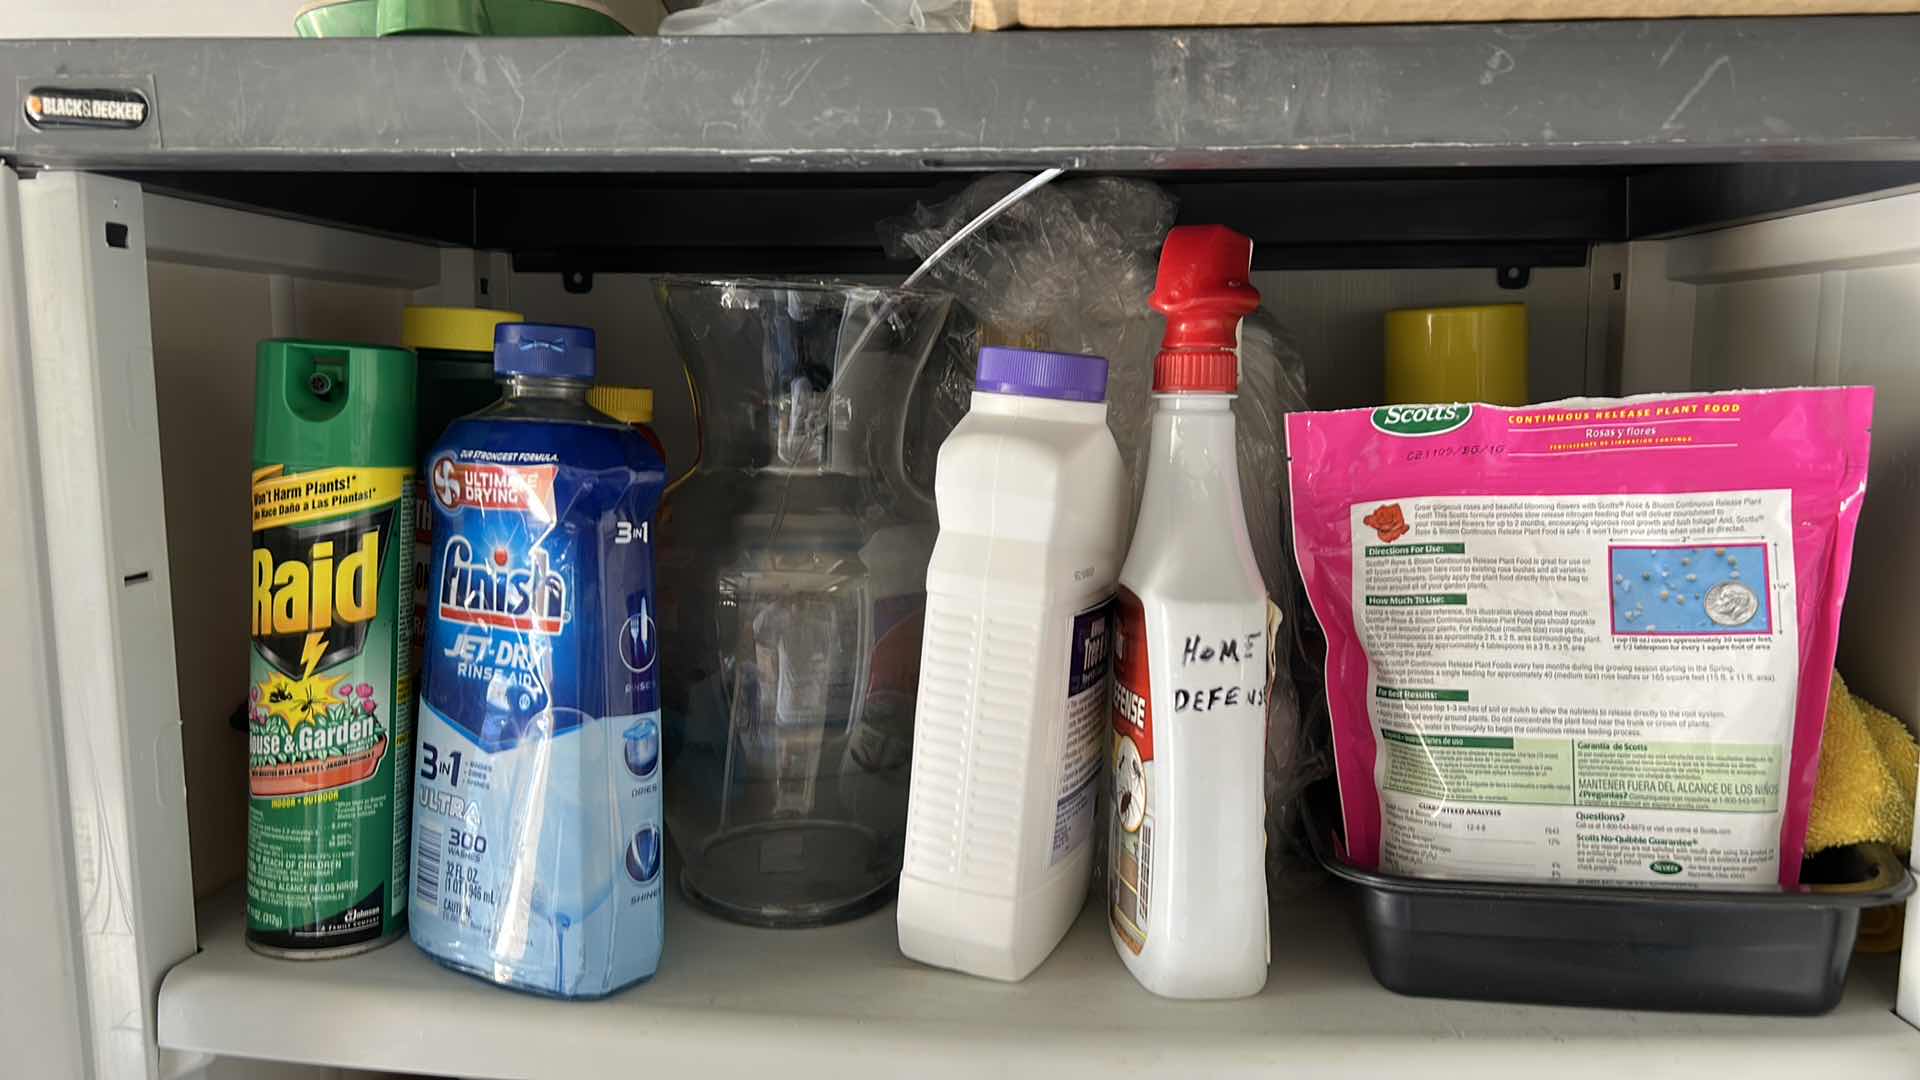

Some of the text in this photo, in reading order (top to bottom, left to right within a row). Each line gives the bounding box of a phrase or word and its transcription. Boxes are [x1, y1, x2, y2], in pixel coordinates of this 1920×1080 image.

[41, 97, 144, 121] BLACK&DECKER
[1384, 406, 1456, 424] Scotts
[1508, 403, 1740, 425] CONTINUOUS RELEASE PLANT FOOD
[1585, 426, 1656, 440] Rosas y flores
[473, 450, 517, 462] STRONGEST
[464, 471, 539, 488] ULTIME
[273, 485, 302, 502] Harm
[465, 487, 518, 503] DRYING
[311, 498, 329, 510] Las
[1369, 545, 1444, 556] Directions For Use:
[252, 528, 379, 636] Raid
[1369, 597, 1387, 605] How
[1388, 596, 1413, 605] Much
[1425, 595, 1445, 604] Use:
[511, 671, 532, 687] AID
[249, 734, 281, 756] ouse
[284, 734, 296, 755] &
[299, 716, 374, 753] Garden
[1578, 778, 1779, 796] MANTENER FUERA DEL ALCANCE DE LOS NIÑOS
[303, 790, 339, 806] OUTDOOR
[419, 785, 481, 825] ULTRA
[1418, 801, 1466, 815] GUARNTEED
[1465, 808, 1502, 818] ANALYSIS
[1575, 811, 1625, 823] Questions?
[448, 828, 487, 854] 300
[1576, 833, 1600, 843] Scotts
[298, 860, 342, 870] CHILDREN
[443, 897, 472, 918] CAUTIN
